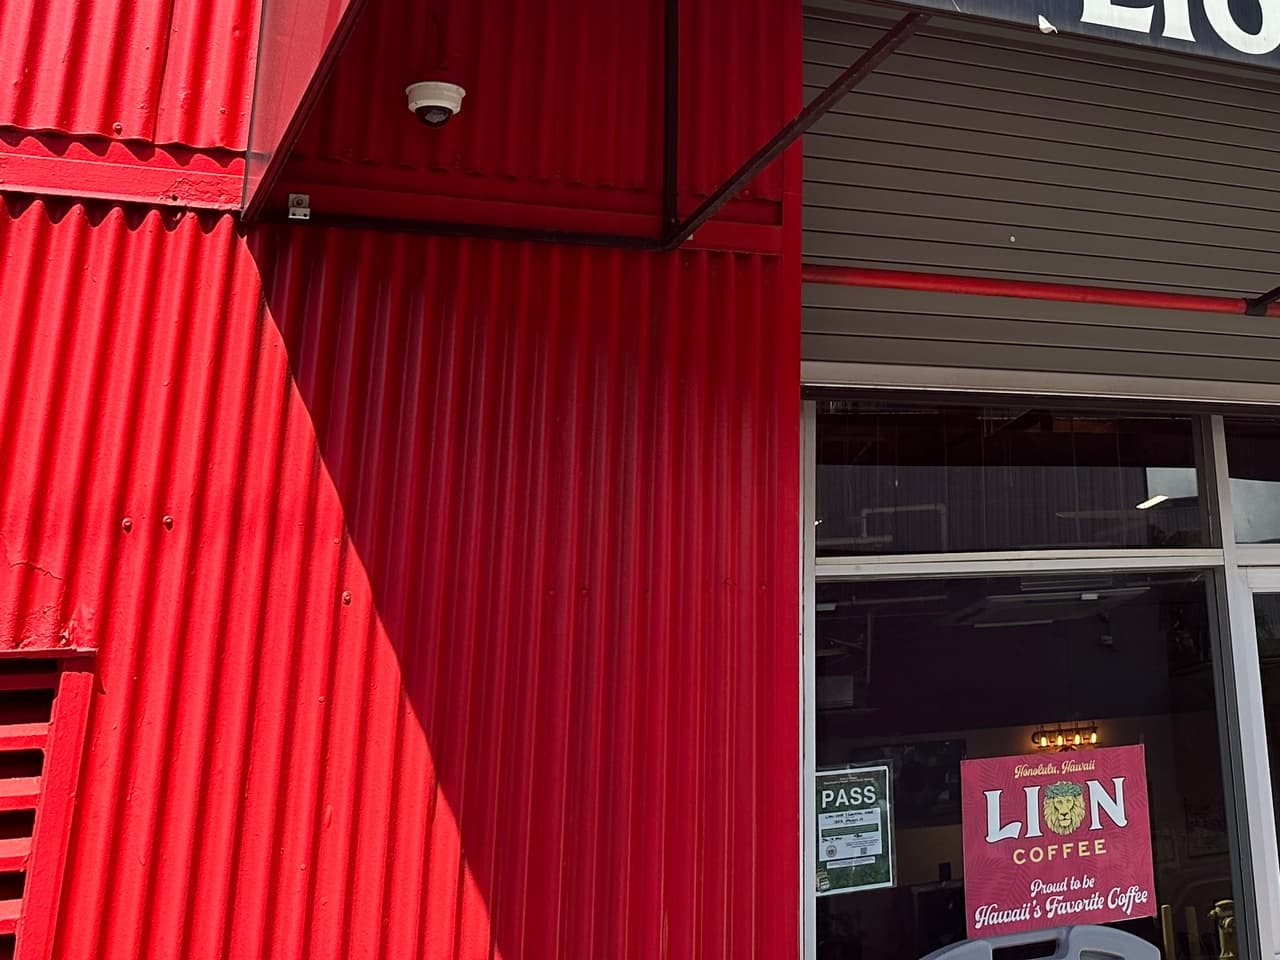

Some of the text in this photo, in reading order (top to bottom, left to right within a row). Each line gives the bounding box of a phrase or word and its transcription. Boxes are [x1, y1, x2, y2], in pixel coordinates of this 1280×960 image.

[1061, 759, 1096, 775] Hawaii
[822, 785, 876, 808] PASS
[1013, 839, 1107, 865] COFFEE
[1030, 874, 1095, 897] Proud to be
[975, 885, 1148, 929] Hawaii's Favorite Coffee
